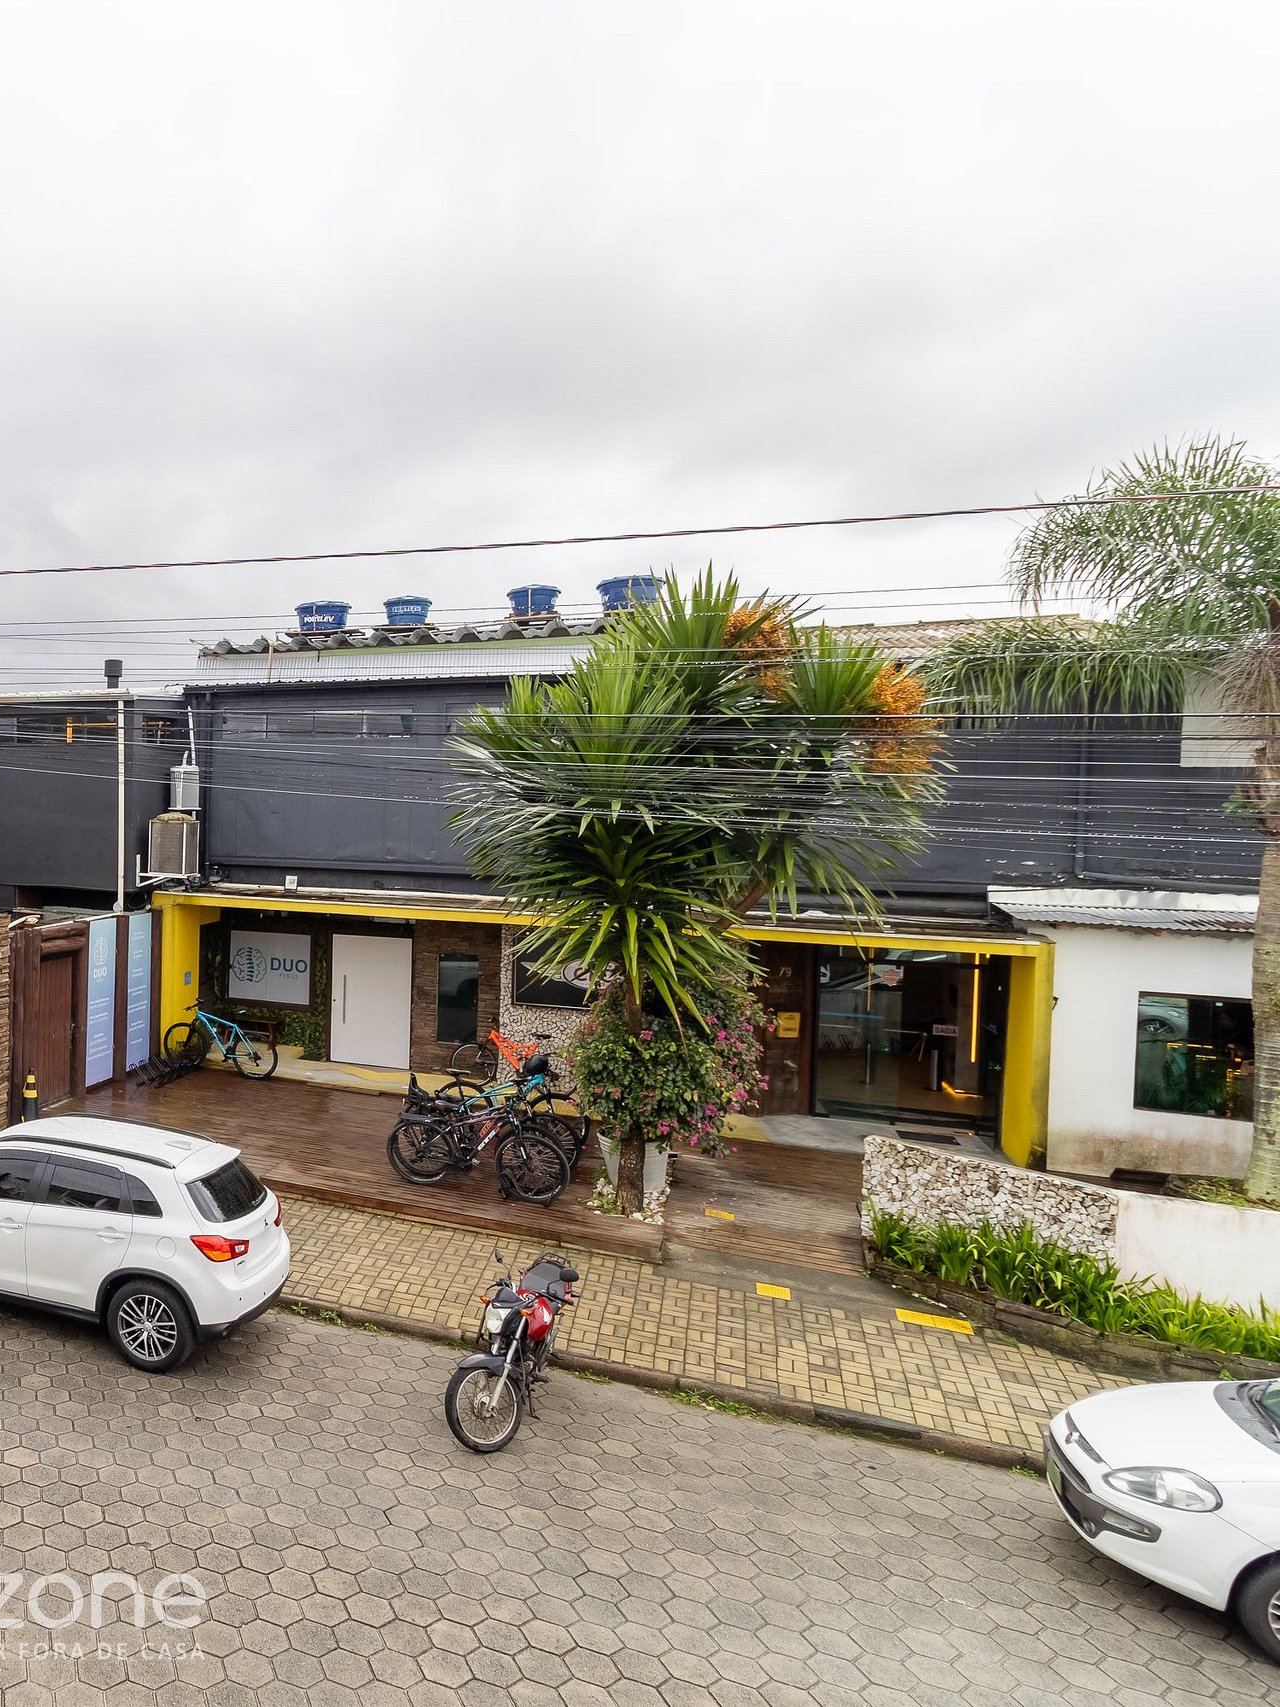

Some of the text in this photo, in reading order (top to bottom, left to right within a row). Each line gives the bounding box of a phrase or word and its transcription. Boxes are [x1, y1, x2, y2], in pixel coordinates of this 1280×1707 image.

[270, 956, 308, 973] DUO
[93, 966, 108, 978] DUO
[779, 967, 792, 977] 79
